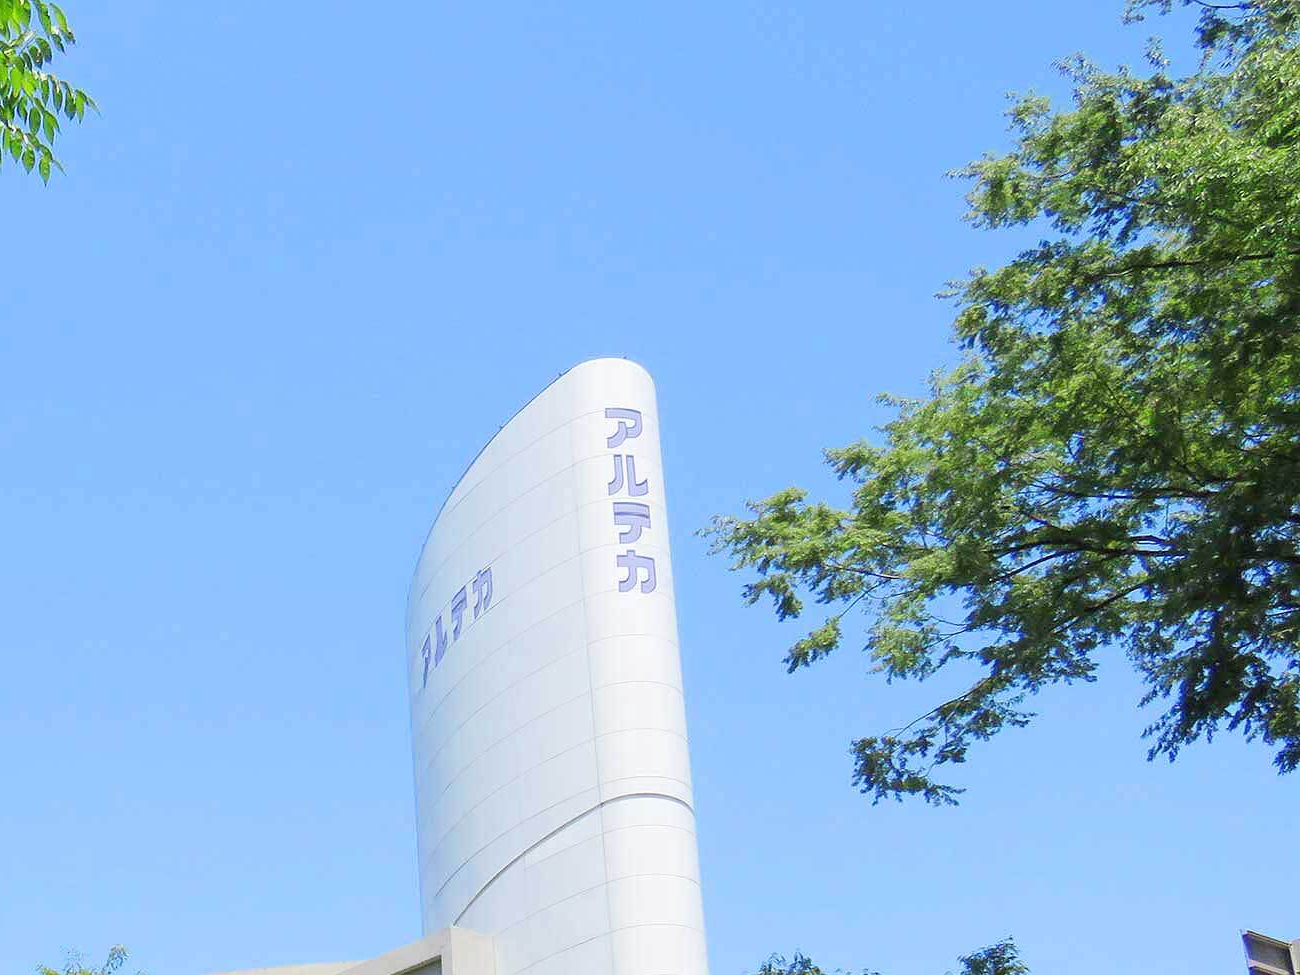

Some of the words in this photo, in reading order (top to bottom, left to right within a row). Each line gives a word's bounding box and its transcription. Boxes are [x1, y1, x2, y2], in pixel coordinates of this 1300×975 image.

[604, 407, 657, 594] アルテカ
[421, 567, 493, 688] アルテカ
